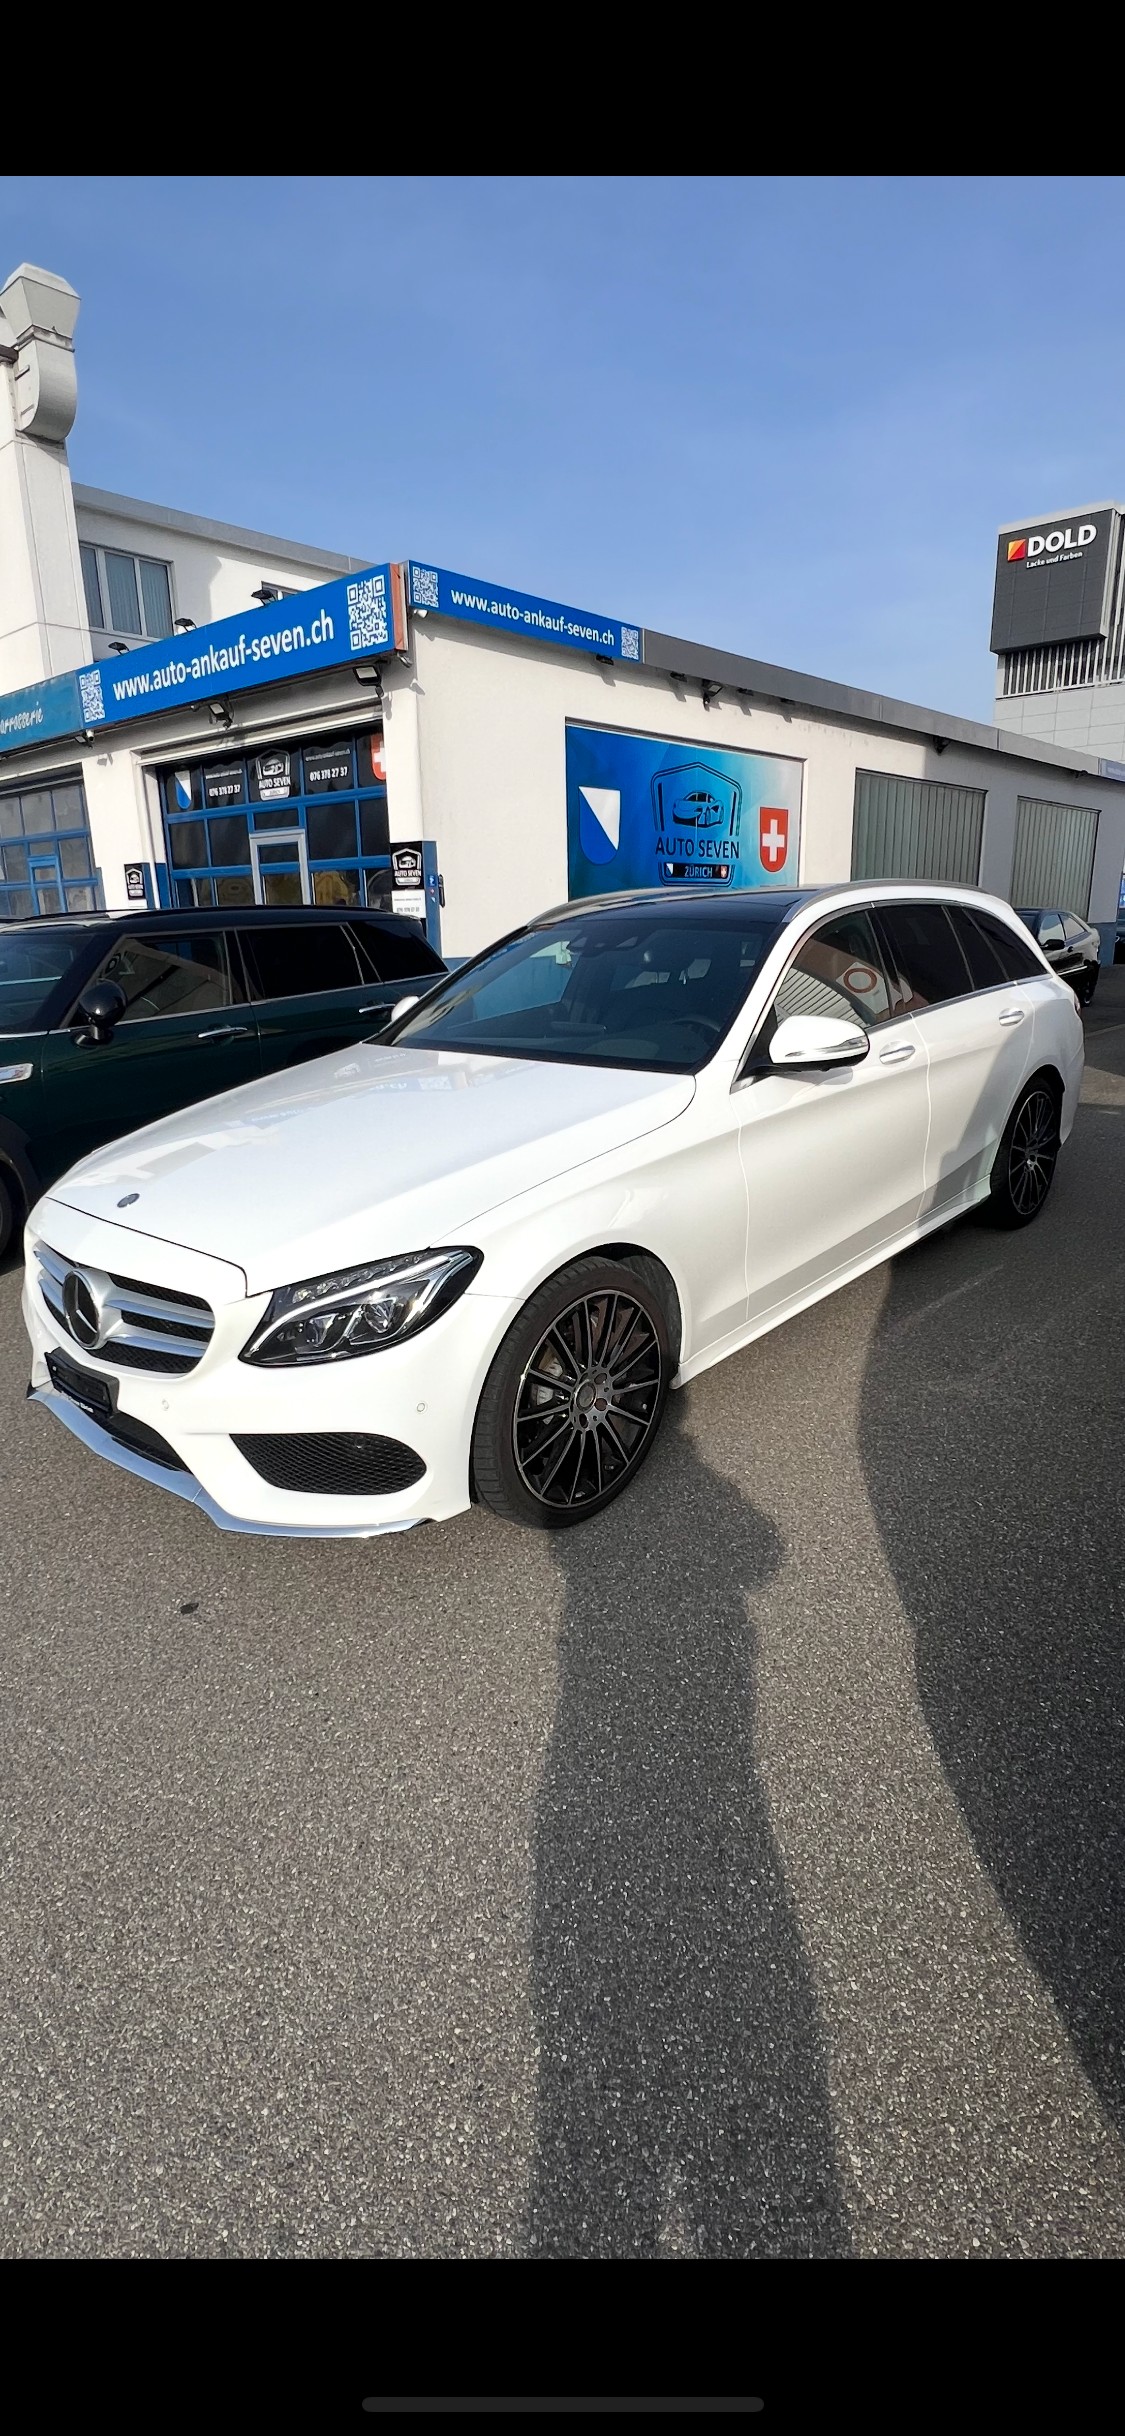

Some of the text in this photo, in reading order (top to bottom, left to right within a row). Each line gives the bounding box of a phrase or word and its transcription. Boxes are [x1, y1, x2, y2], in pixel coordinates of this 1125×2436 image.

[1027, 524, 1097, 557] DOLD
[1026, 551, 1083, 569] Lacke und Farben
[451, 589, 615, 646] www.auto-ankauf-seven.ch
[112, 608, 334, 701] www.auto-ankauf-seven.ch
[258, 776, 291, 789] AUTO SEVEN
[309, 770, 321, 782] 076
[331, 767, 340, 778] 27
[340, 766, 348, 776] 37
[655, 836, 740, 859] AUTO SEVEN
[684, 864, 713, 878] ZÜRICH
